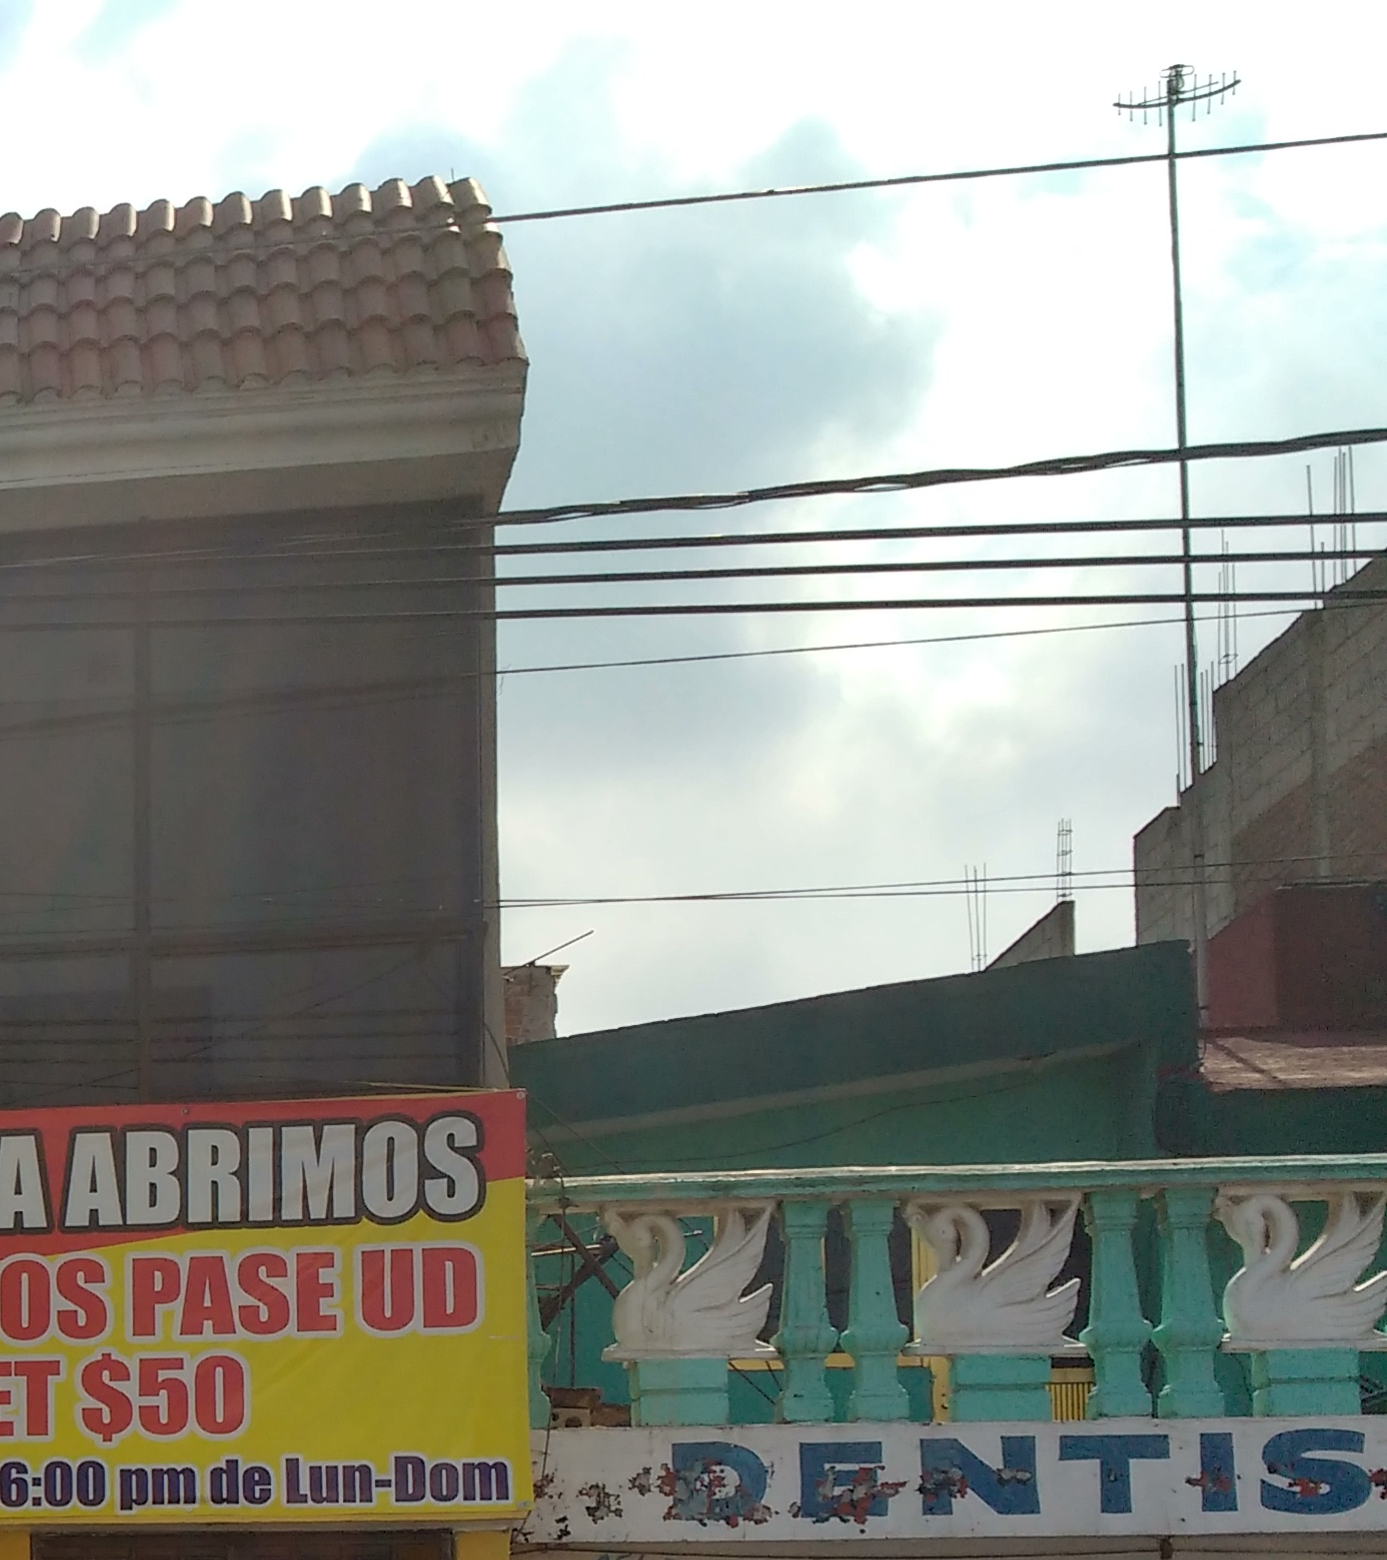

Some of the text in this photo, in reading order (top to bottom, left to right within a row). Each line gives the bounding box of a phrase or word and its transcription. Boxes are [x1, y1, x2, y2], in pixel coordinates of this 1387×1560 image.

[60, 1114, 485, 1232] ABRIMOS
[130, 1250, 339, 1337] PASE
[359, 1245, 481, 1333] UD
[80, 1353, 247, 1444] $50
[117, 1465, 199, 1511] pm
[205, 1457, 273, 1507] de
[283, 1454, 510, 1506] Lun-Dom
[670, 1428, 1372, 1523] DENTIS
